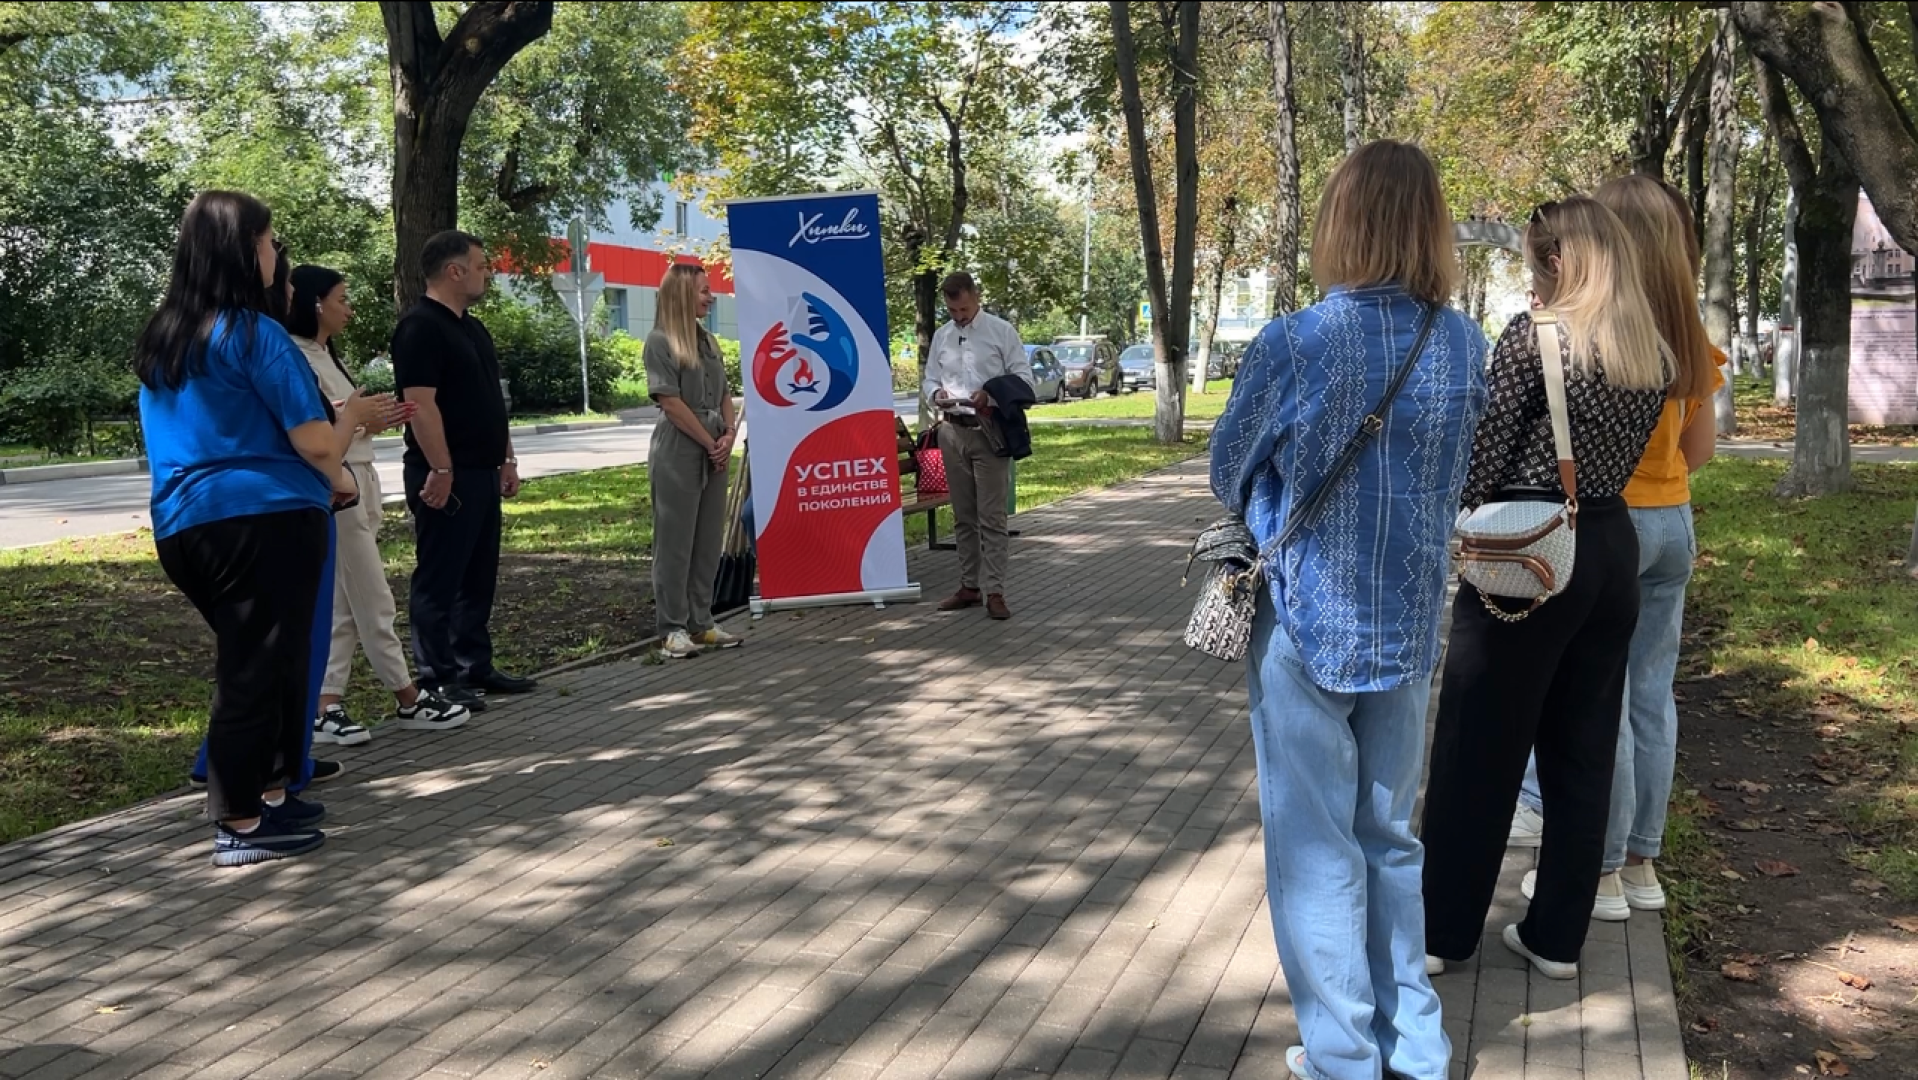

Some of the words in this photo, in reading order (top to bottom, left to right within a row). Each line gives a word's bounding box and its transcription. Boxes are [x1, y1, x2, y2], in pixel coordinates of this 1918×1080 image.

[788, 207, 870, 248] Химки
[795, 457, 887, 482] УСПЕХ
[797, 487, 807, 497] В
[811, 479, 888, 496] ЕДИНСТВЕ
[798, 492, 891, 512] ПОКОЛЕНИЙ
